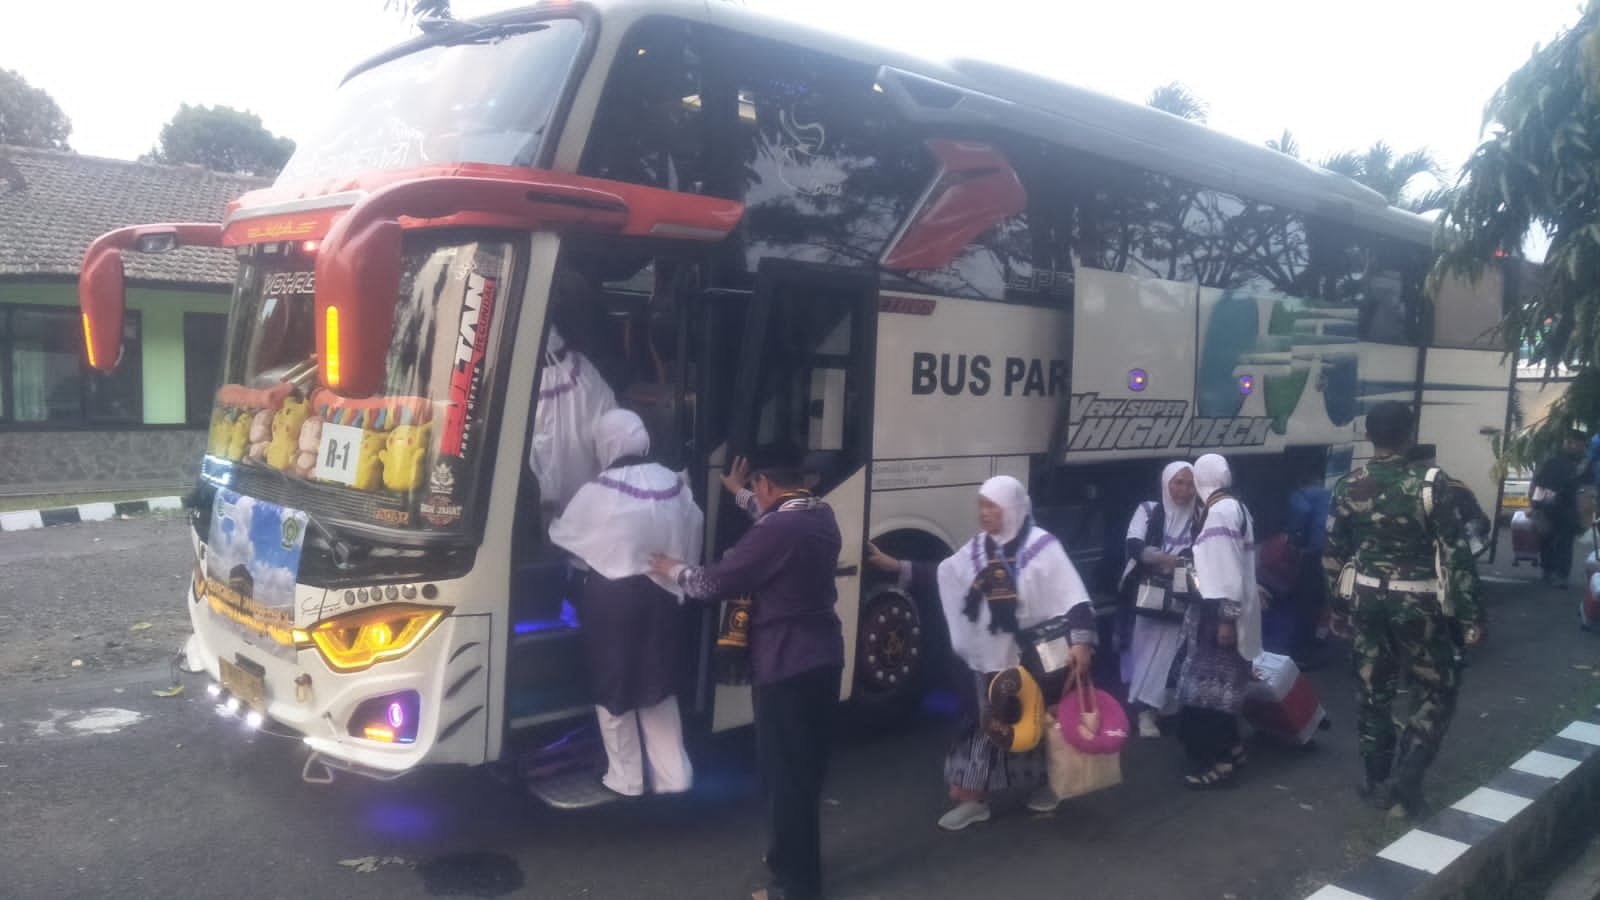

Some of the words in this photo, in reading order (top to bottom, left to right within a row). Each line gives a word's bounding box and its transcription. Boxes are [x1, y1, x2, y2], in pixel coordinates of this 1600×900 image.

[911, 351, 992, 396] BUS
[1068, 415, 1184, 451] HIGH
[1177, 415, 1273, 447] DECK
[325, 438, 351, 471] R-1
